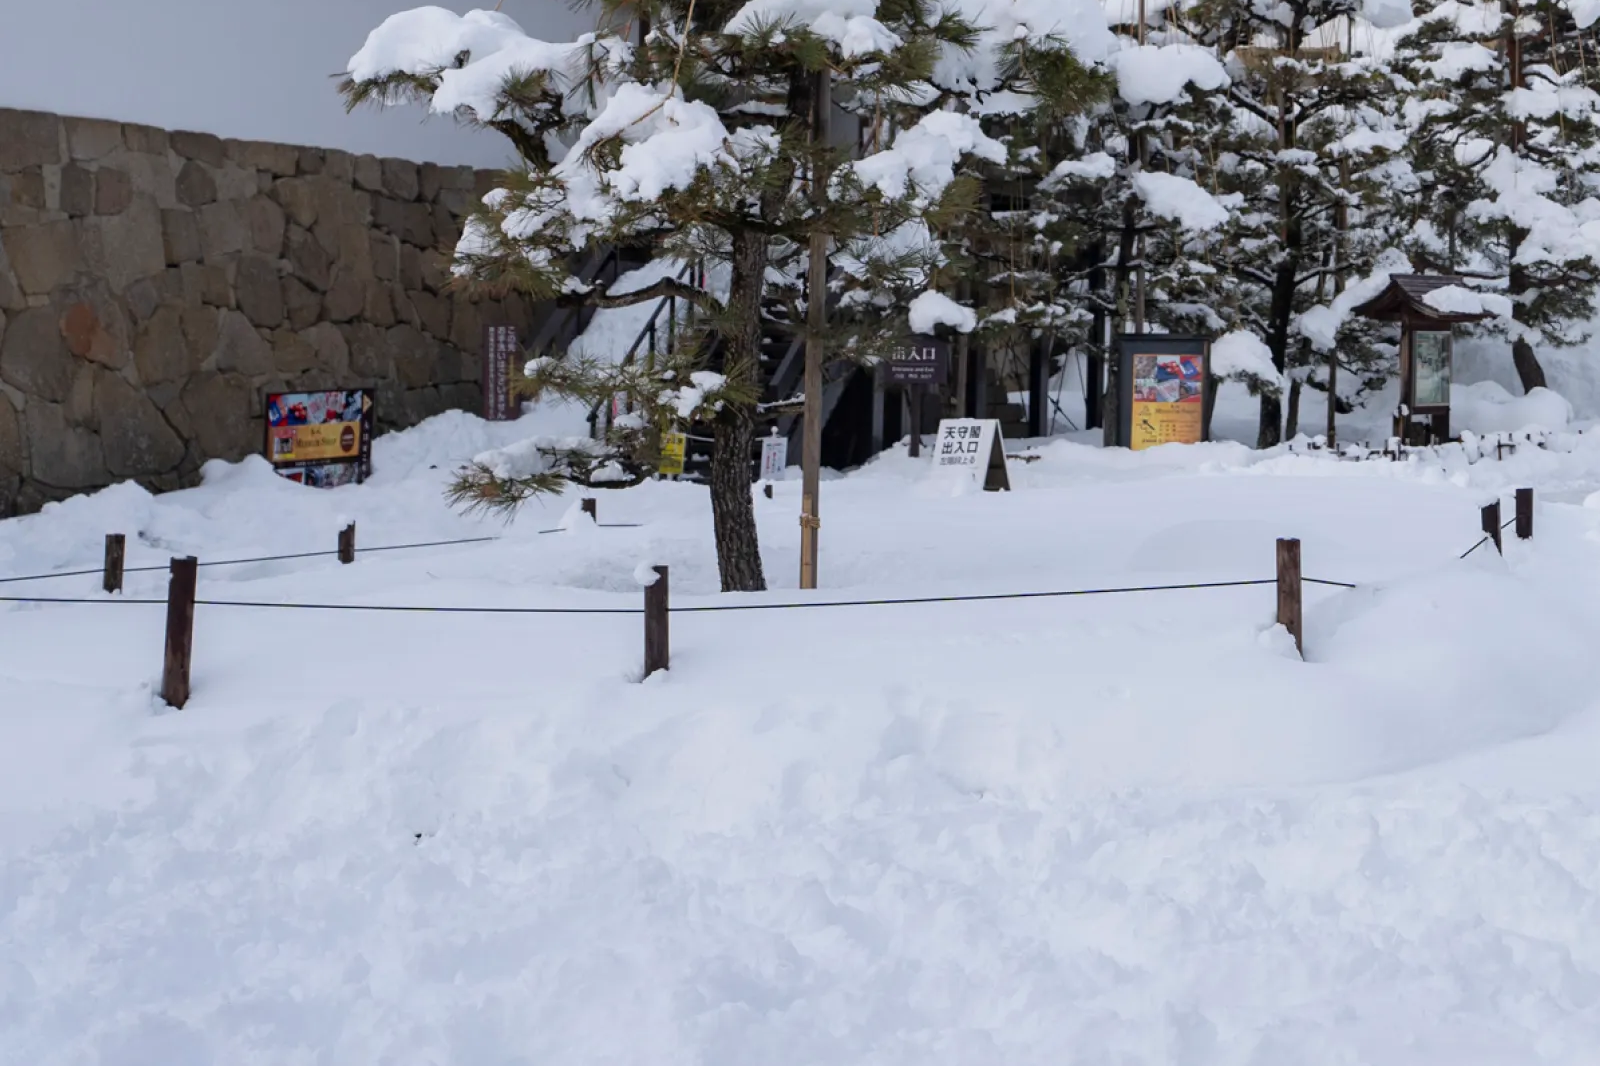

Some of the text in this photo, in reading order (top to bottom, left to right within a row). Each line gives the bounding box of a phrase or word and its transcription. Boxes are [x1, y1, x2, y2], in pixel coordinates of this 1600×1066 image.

[892, 346, 936, 360] 出入口
[944, 425, 981, 439] 天守閣
[942, 441, 979, 454] 出入口
